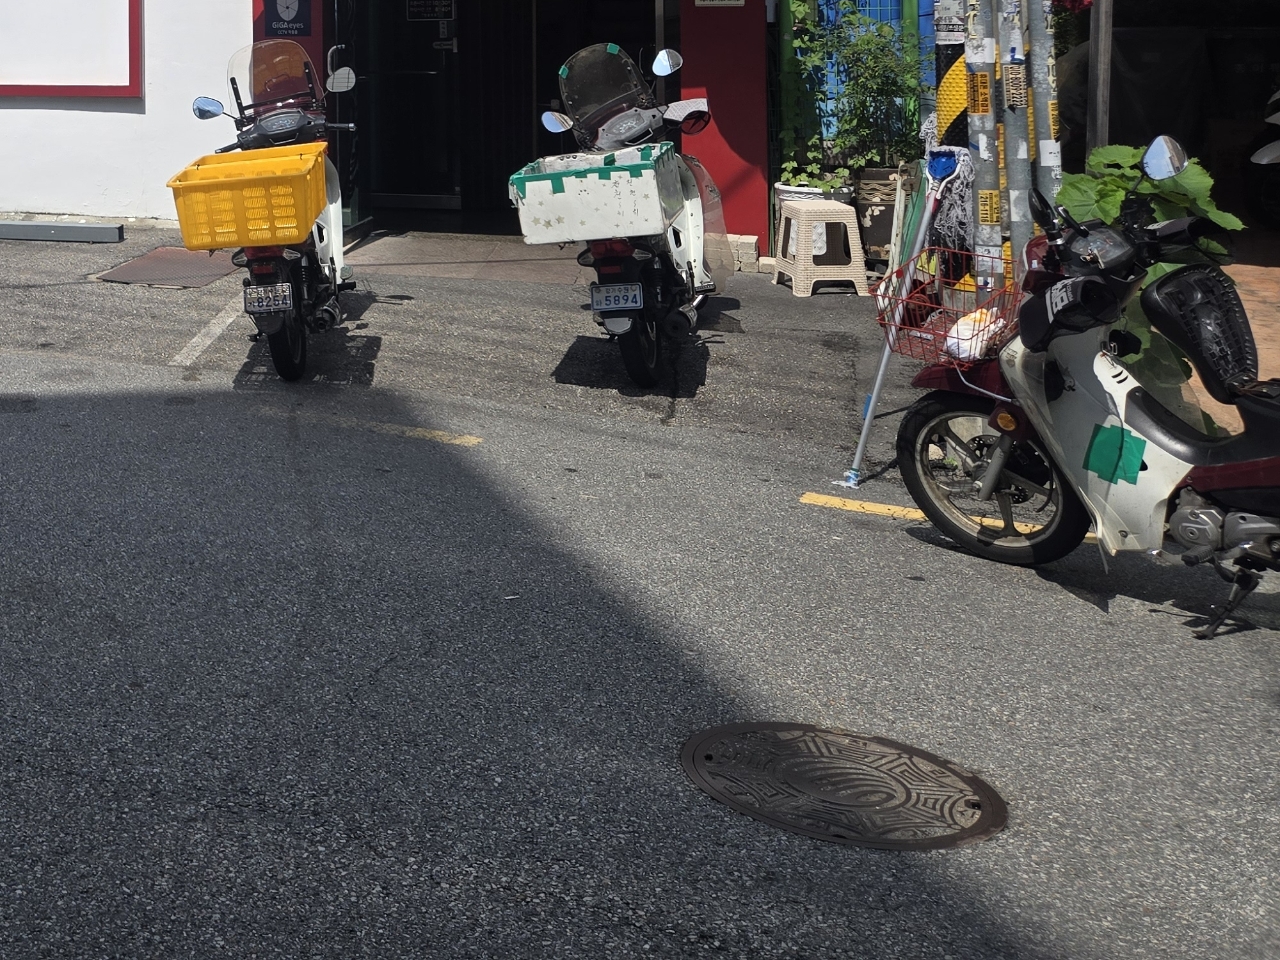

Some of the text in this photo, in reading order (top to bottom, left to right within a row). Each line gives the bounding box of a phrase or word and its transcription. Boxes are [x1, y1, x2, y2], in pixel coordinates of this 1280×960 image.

[289, 22, 304, 30] eyes
[257, 295, 288, 308] 8254
[605, 294, 638, 307] 5894
